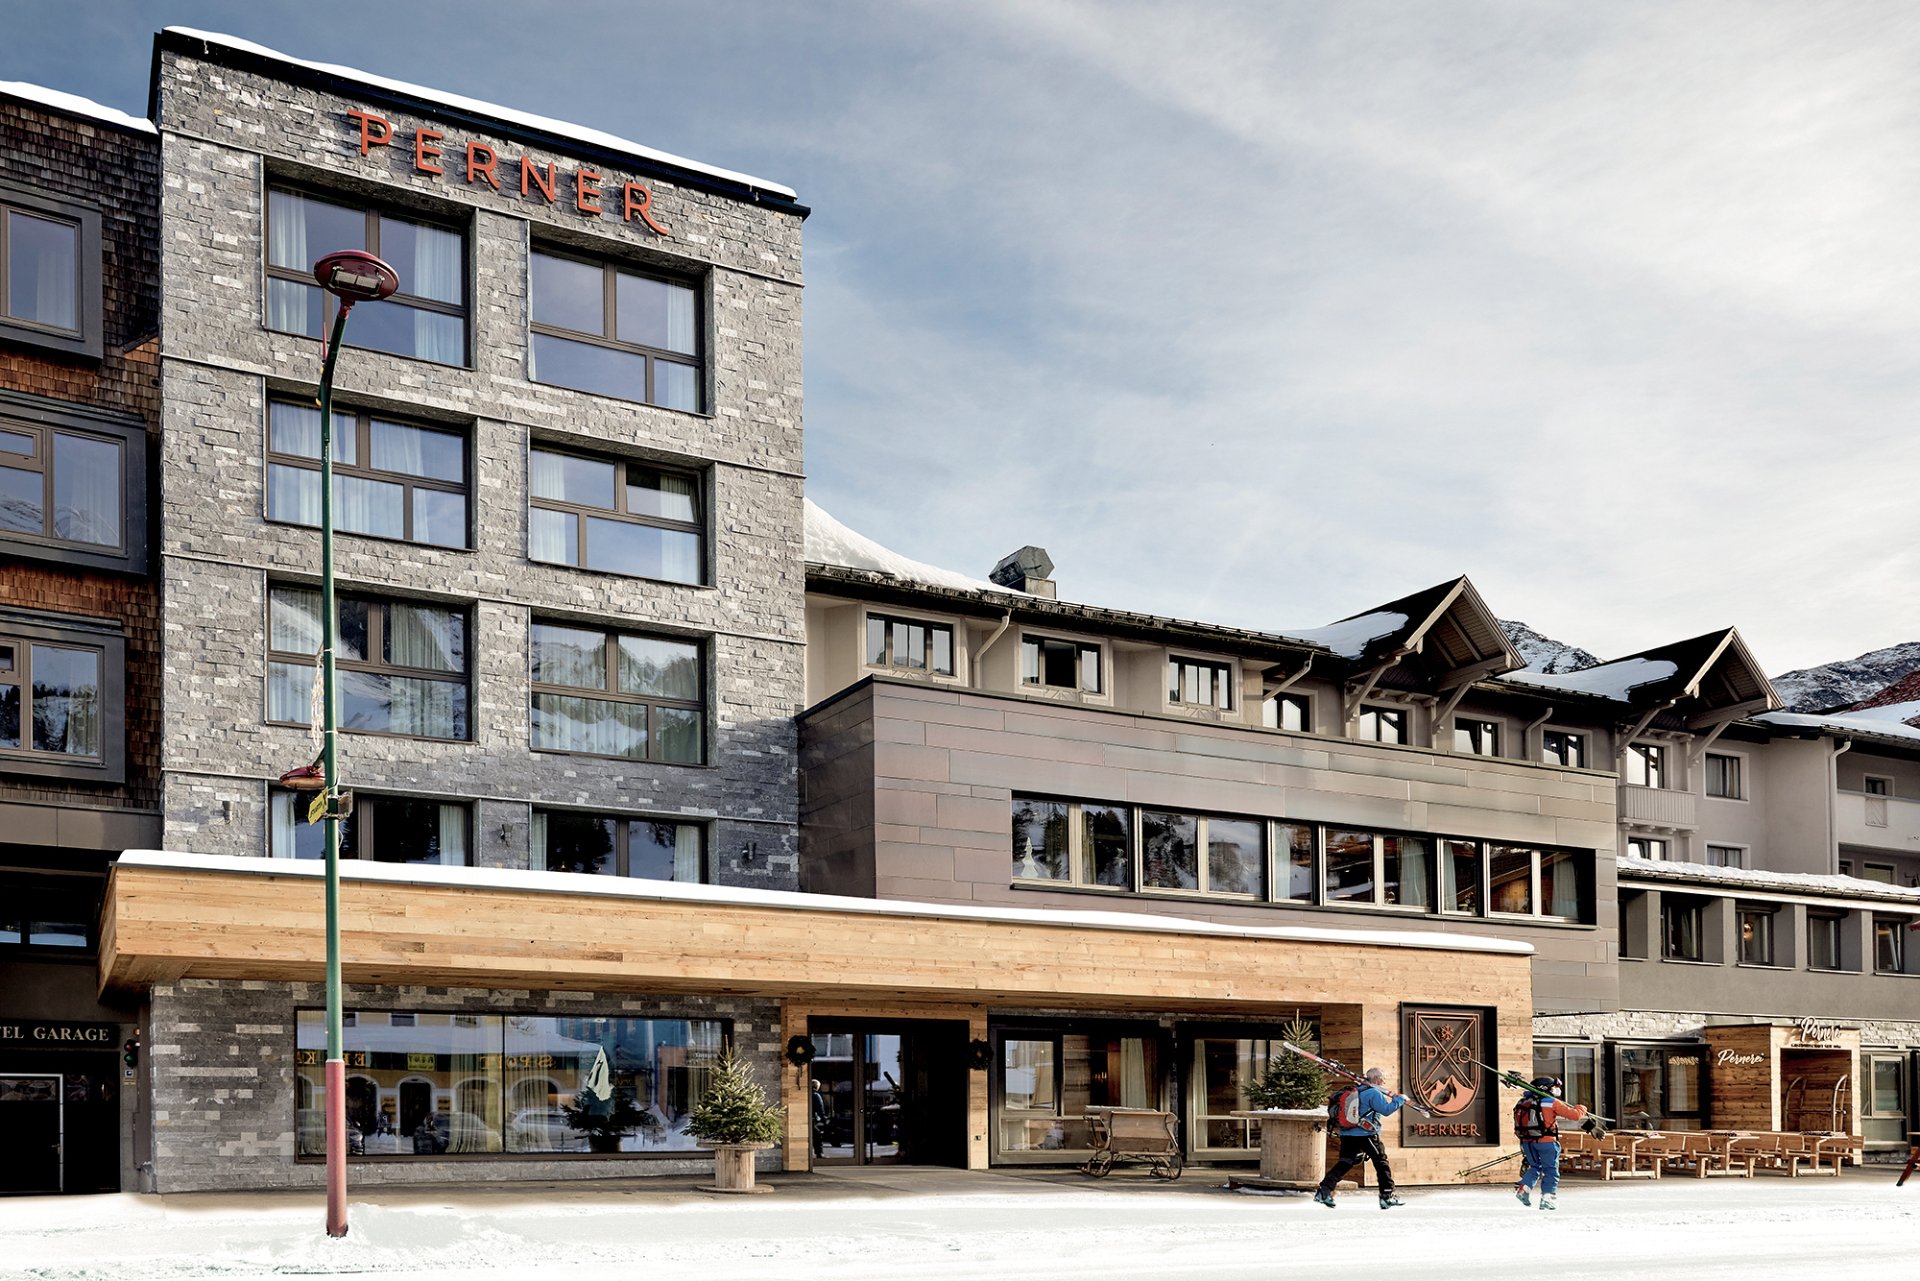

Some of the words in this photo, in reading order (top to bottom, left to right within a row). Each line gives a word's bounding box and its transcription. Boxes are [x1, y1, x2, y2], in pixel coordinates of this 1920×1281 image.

[347, 109, 670, 236] PERNER
[0, 1026, 24, 1039] EL
[33, 1026, 109, 1041] GARAGE
[1717, 1048, 1765, 1066] Pernerei
[1417, 1123, 1480, 1137] PERNER
